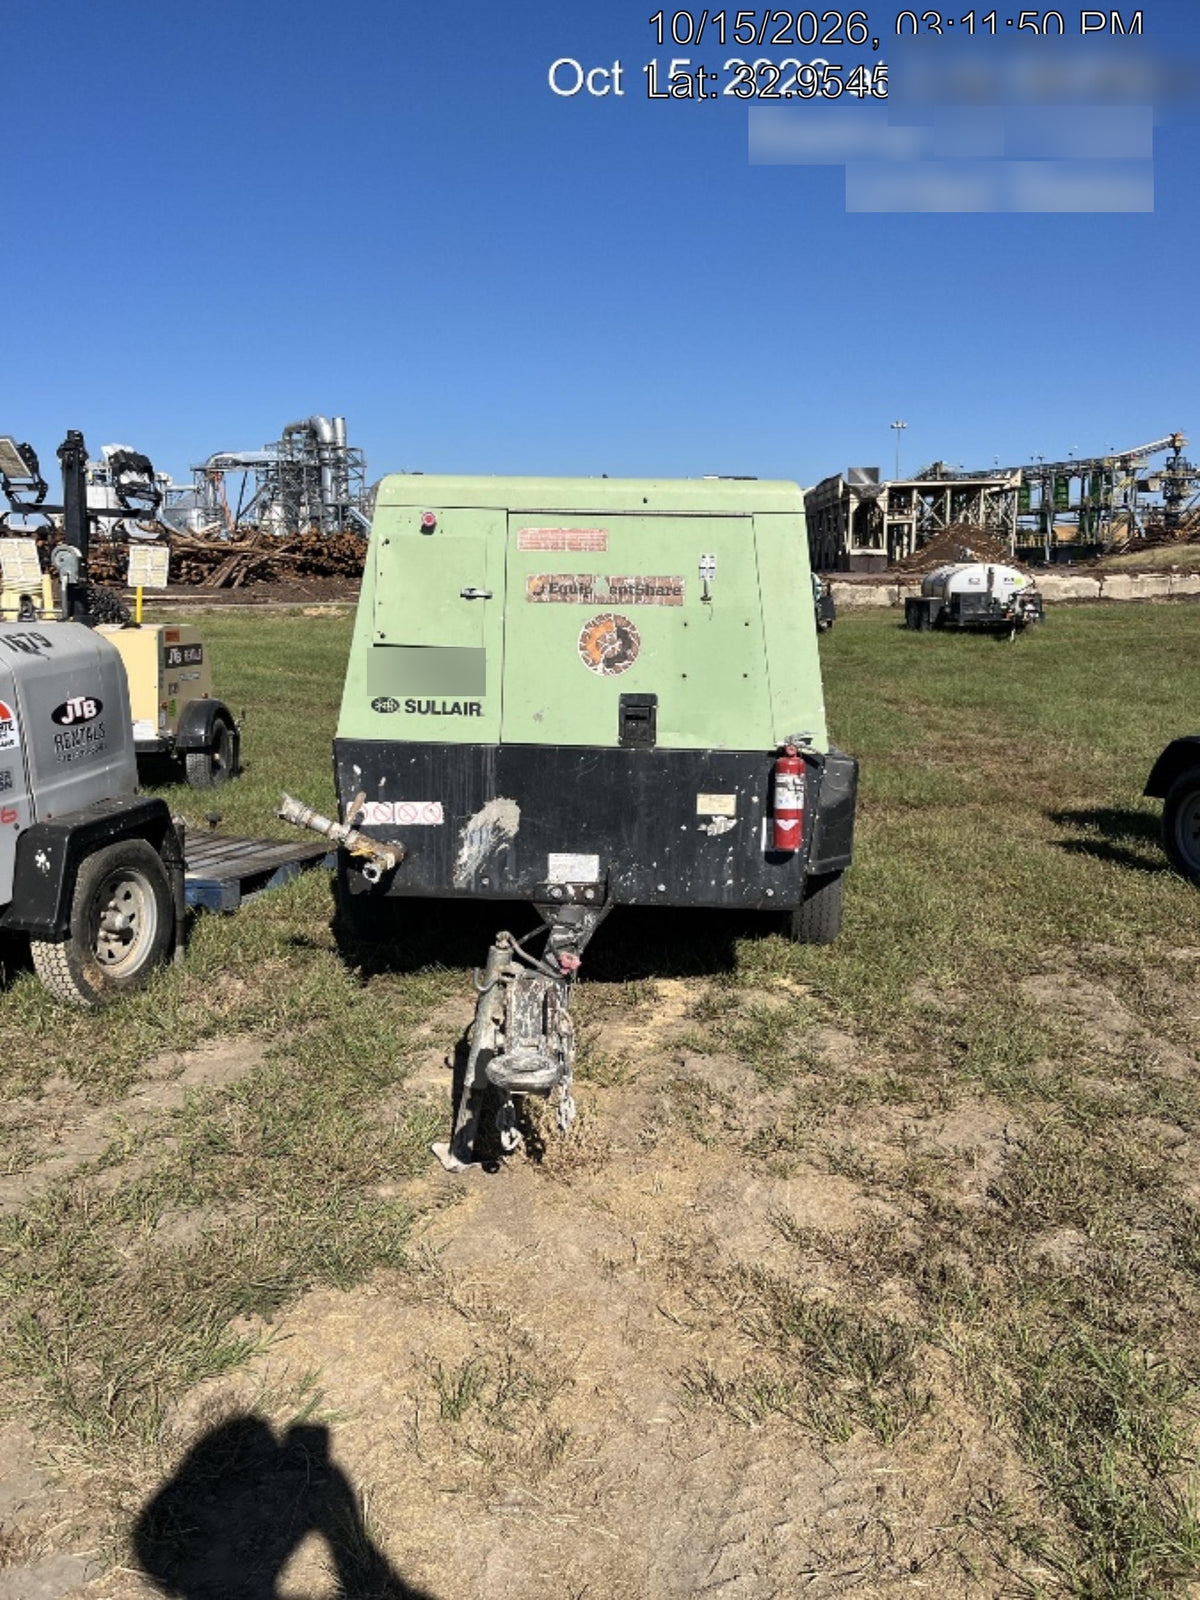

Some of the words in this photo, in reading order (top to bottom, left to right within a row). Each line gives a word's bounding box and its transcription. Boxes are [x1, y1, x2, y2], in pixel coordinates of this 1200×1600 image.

[548, 581, 682, 598] EquipentShare
[61, 696, 97, 724] JTB
[404, 698, 484, 717] SULLAIR
[54, 721, 106, 754] RENTALS
